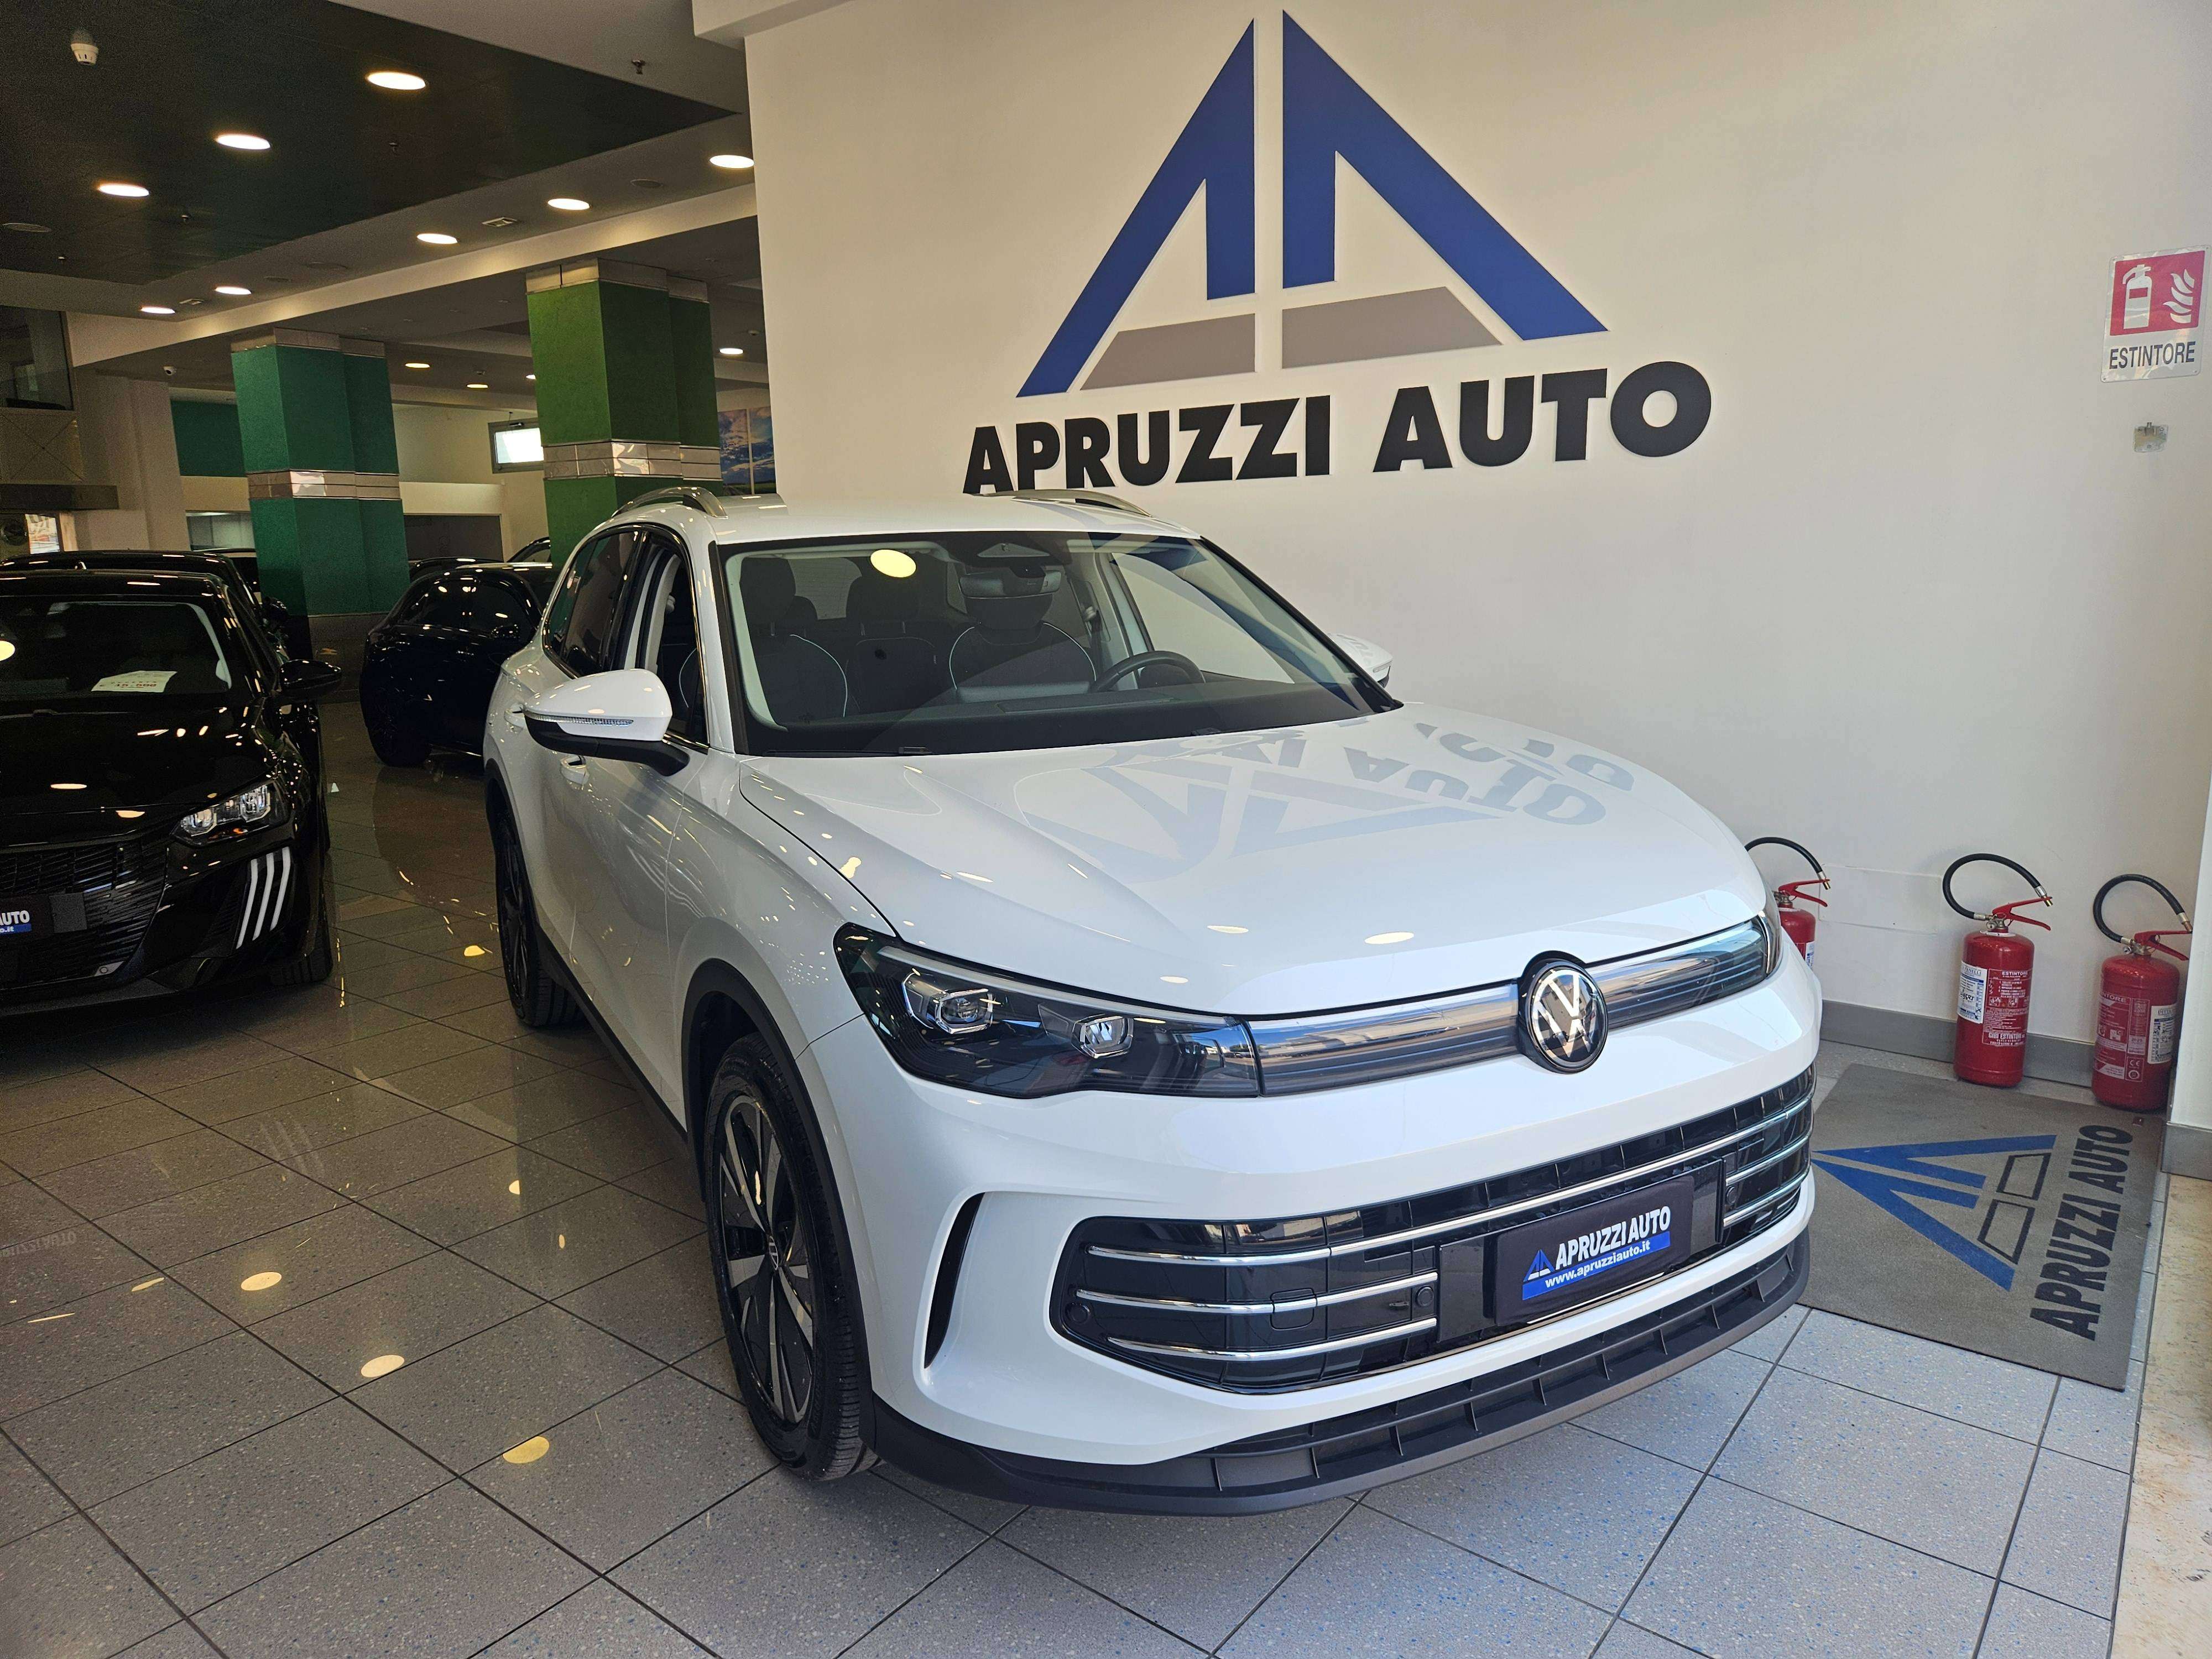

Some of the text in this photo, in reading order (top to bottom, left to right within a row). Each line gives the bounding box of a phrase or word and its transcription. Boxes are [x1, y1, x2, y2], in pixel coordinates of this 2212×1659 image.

[2109, 341, 2196, 370] ESTINTORE
[962, 361, 1712, 494] APRUZZI AUTO
[1545, 1240, 1651, 1288] www.apruzziauto.it
[1556, 1206, 1671, 1270] APRUZZI AUTO
[2030, 1124, 2133, 1341] APRUZZI AUTO
